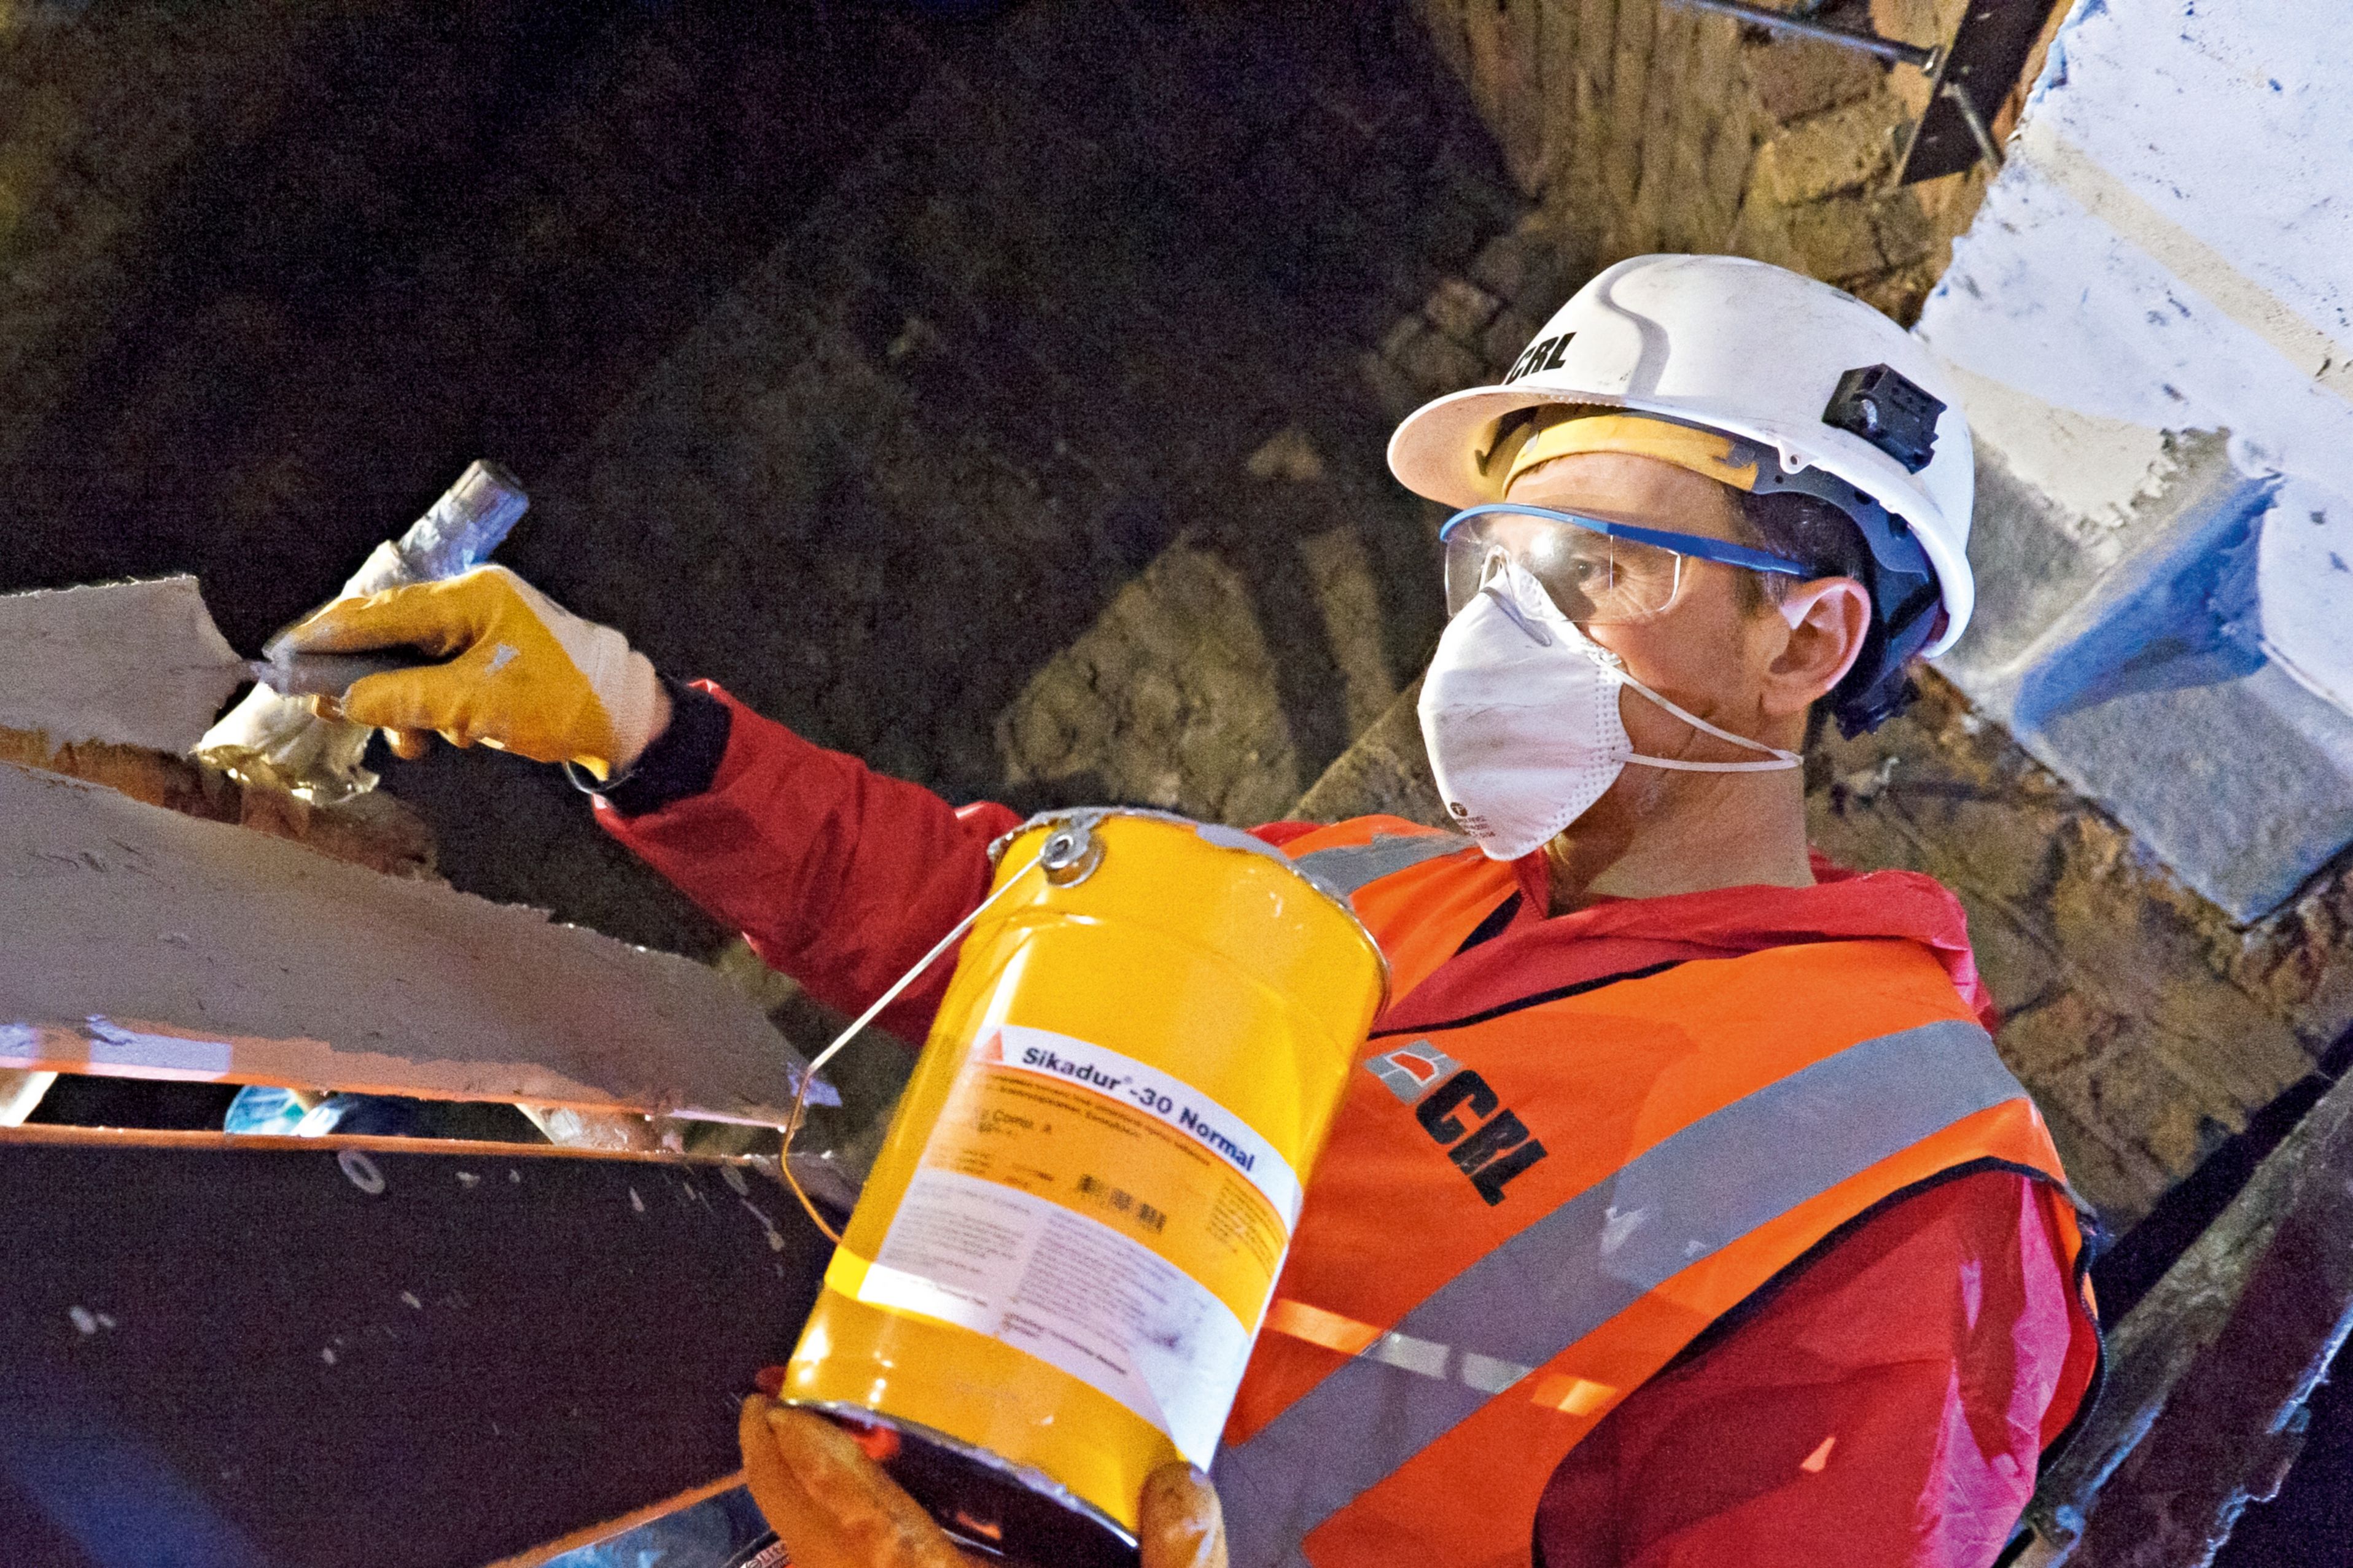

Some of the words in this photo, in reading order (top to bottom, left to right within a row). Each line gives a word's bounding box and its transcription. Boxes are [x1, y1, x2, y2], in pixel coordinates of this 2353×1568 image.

[1506, 332, 1577, 385] CRL
[1179, 1106, 1255, 1171] Normal
[1416, 1070, 1547, 1206] CRL
